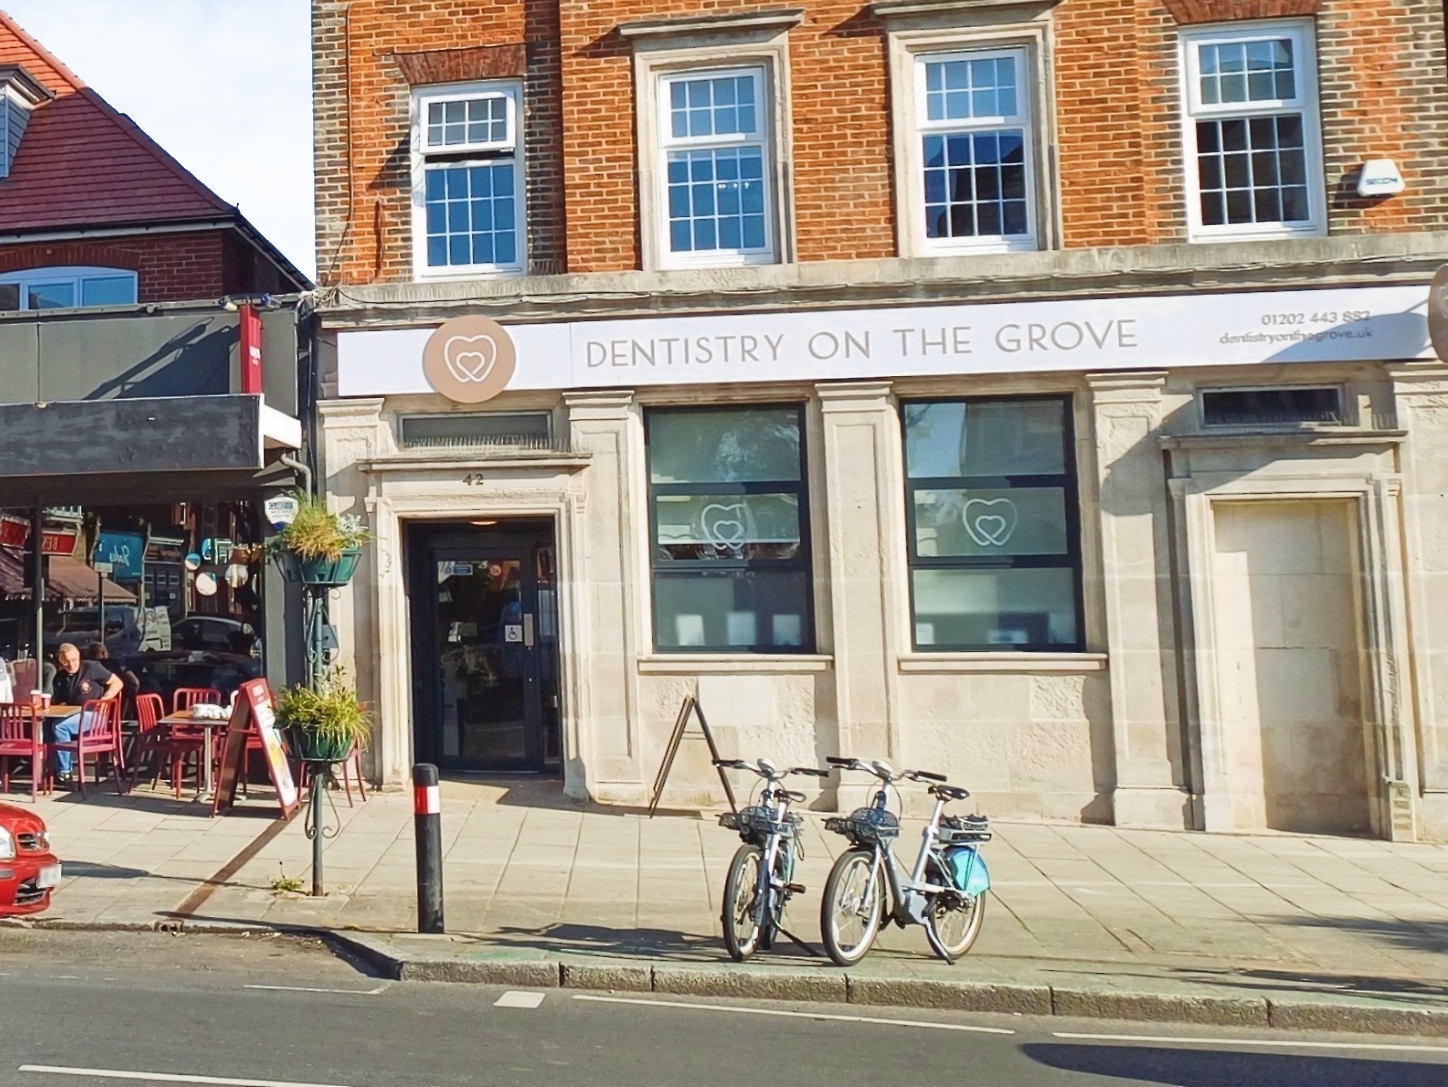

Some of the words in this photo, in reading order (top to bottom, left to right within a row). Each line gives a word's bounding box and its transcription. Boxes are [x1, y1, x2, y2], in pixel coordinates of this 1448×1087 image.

[1261, 313, 1305, 325] 01202
[585, 333, 784, 368] DENTISTRY
[807, 329, 872, 360] ON
[892, 325, 973, 357] THE
[994, 318, 1138, 353] GROVE
[462, 473, 484, 486] 42
